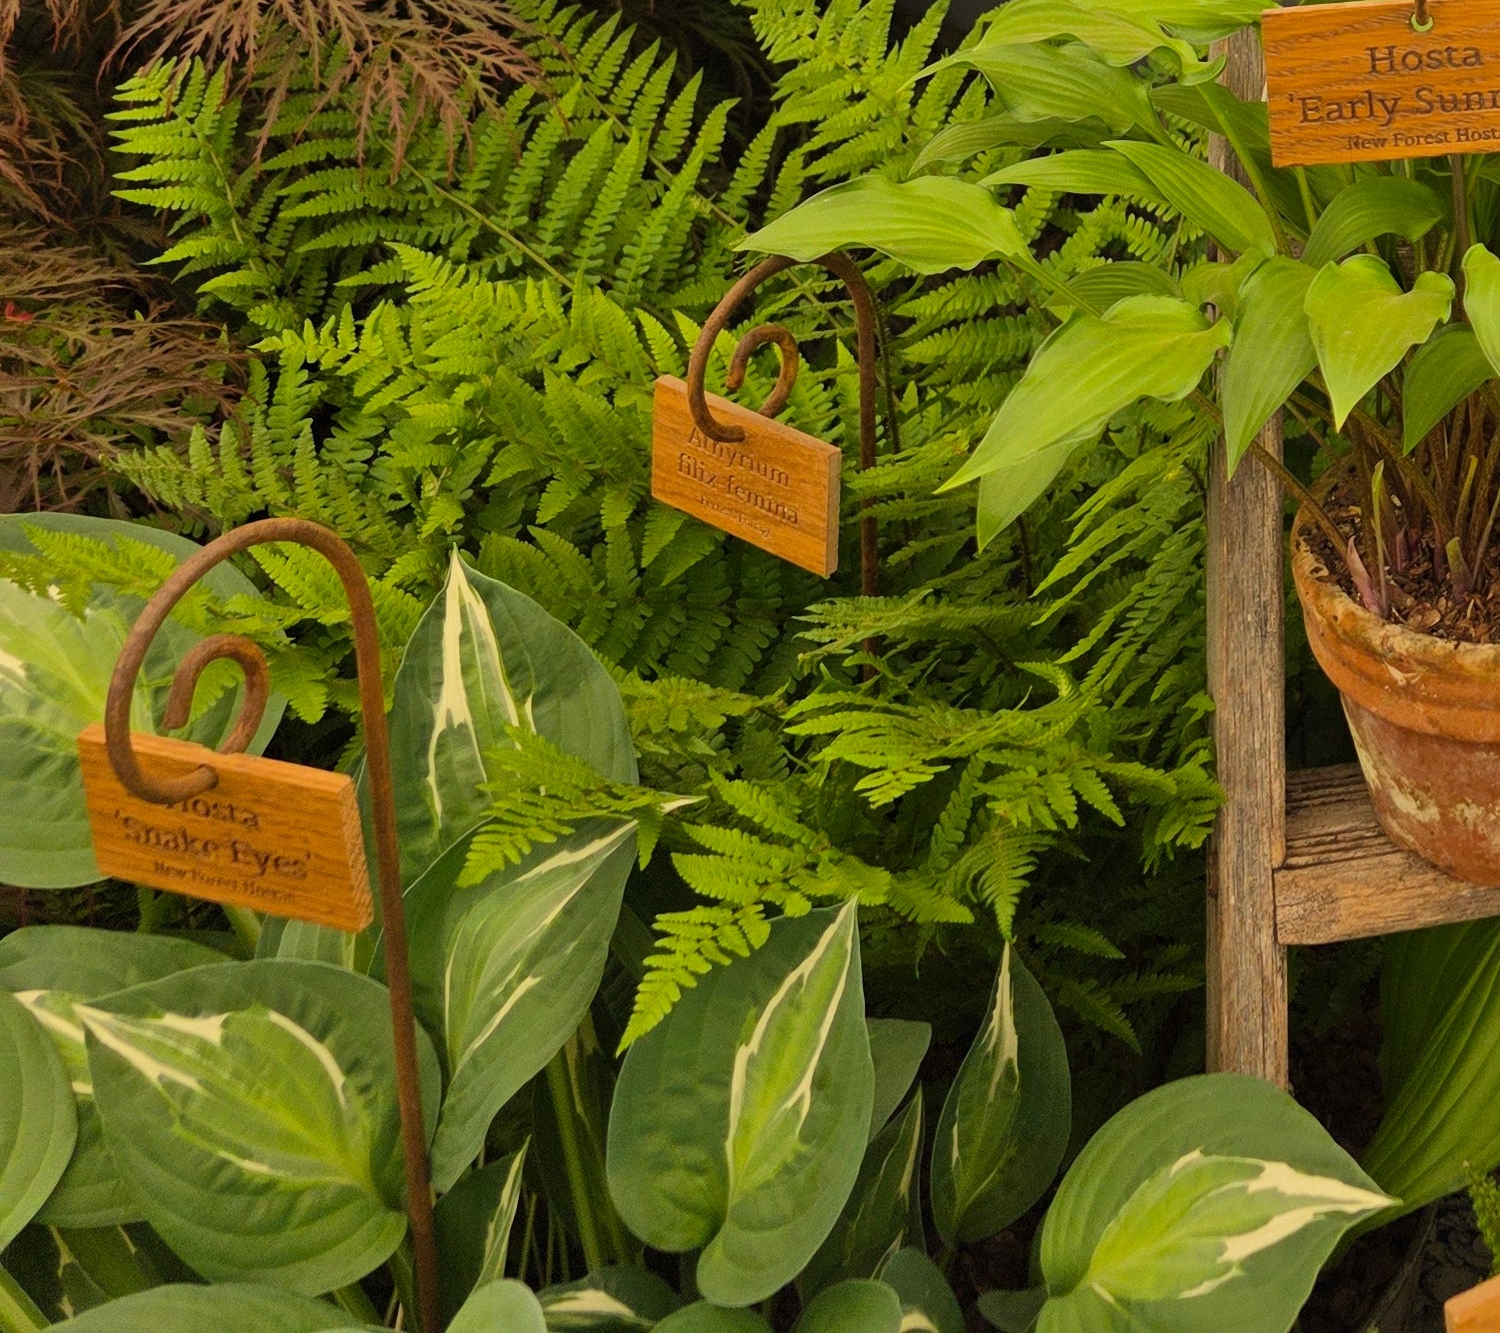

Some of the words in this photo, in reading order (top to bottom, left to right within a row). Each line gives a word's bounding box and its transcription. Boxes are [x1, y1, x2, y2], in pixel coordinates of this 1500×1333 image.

[1366, 45, 1484, 75] Hosta
[1287, 89, 1402, 128] 'Early
[1346, 135, 1388, 151] New
[1393, 131, 1450, 148] Forest
[114, 808, 220, 853] 'Snake
[229, 837, 311, 882] Eyes'
